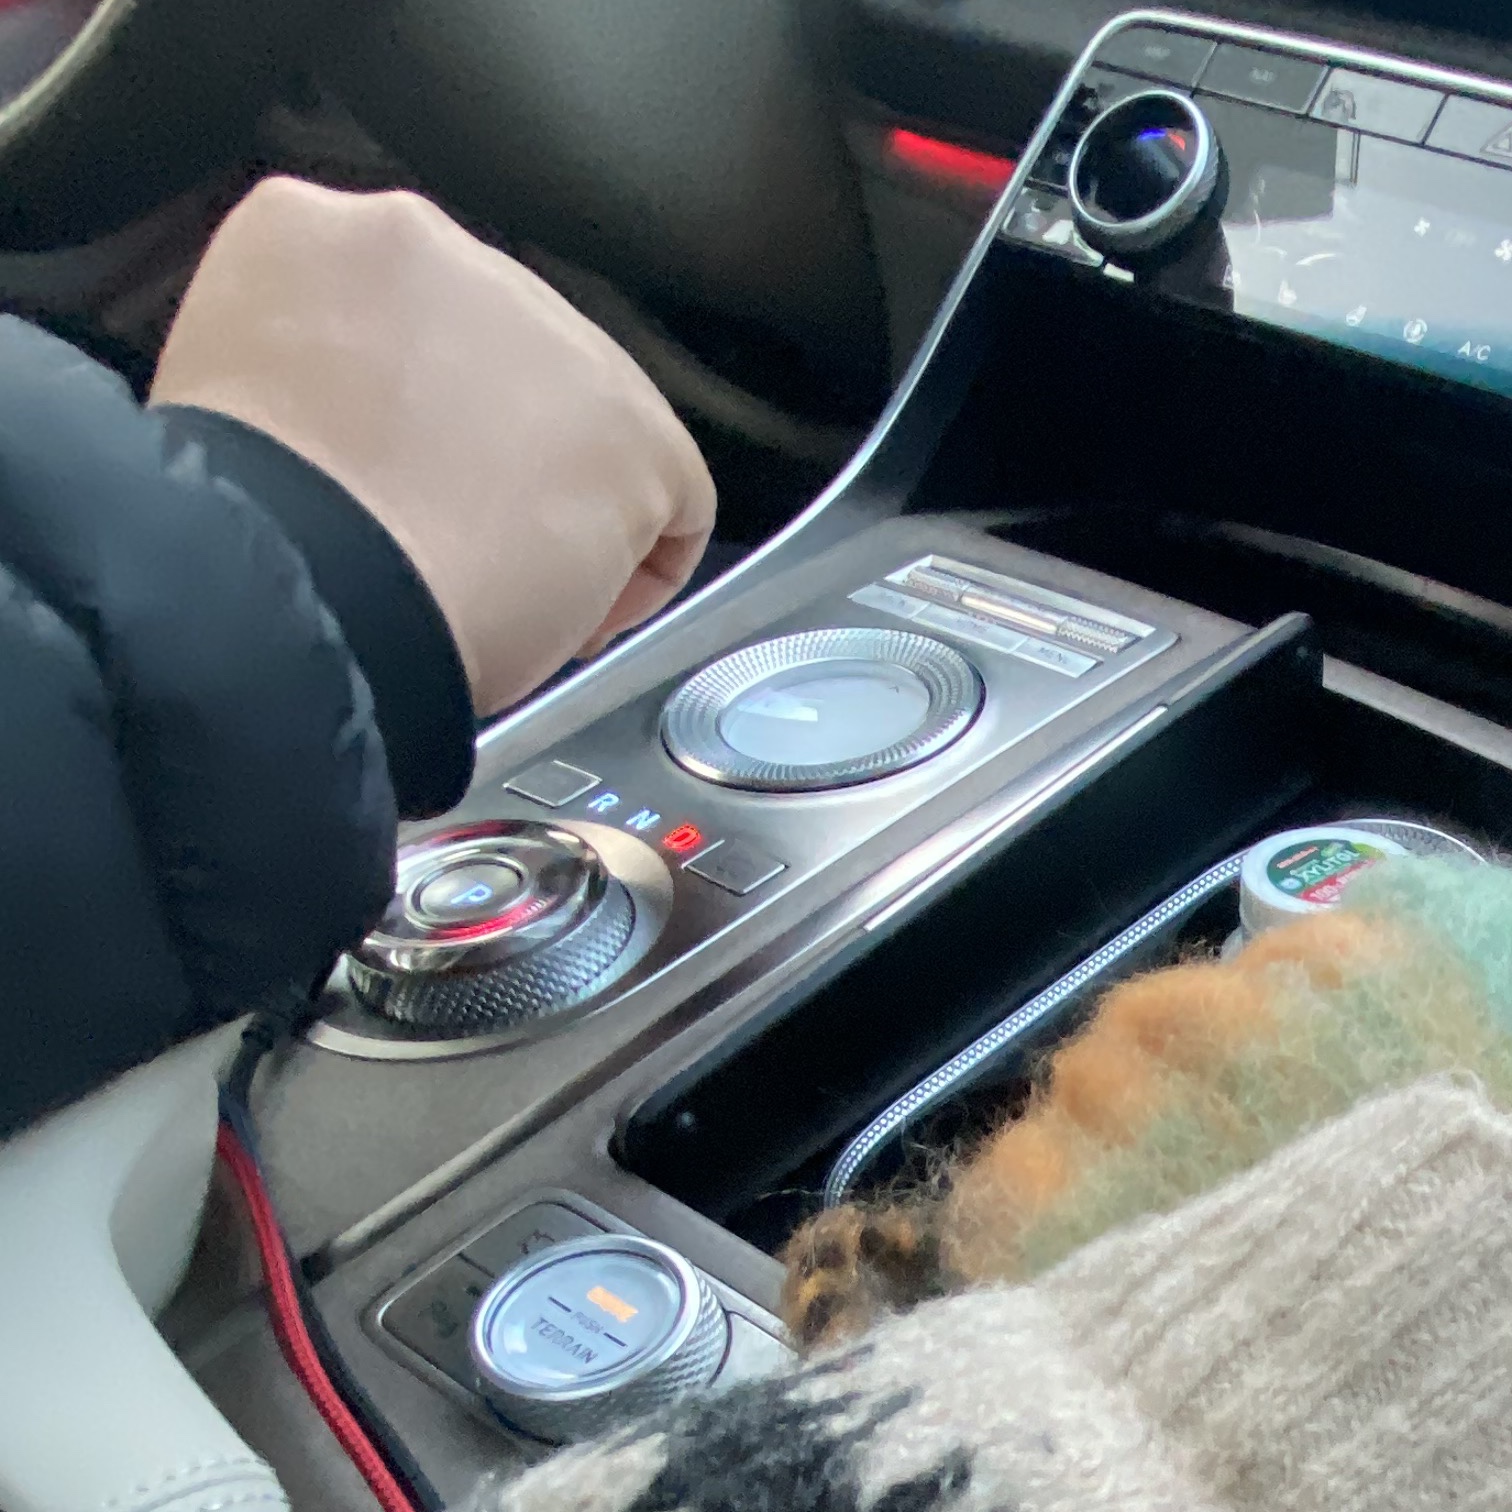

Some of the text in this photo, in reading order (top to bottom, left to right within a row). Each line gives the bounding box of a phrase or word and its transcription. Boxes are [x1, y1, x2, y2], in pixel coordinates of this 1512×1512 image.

[1457, 340, 1491, 361] A/C
[588, 791, 702, 852] R N D
[450, 883, 494, 906] P
[530, 1315, 598, 1364] TERRAIN
